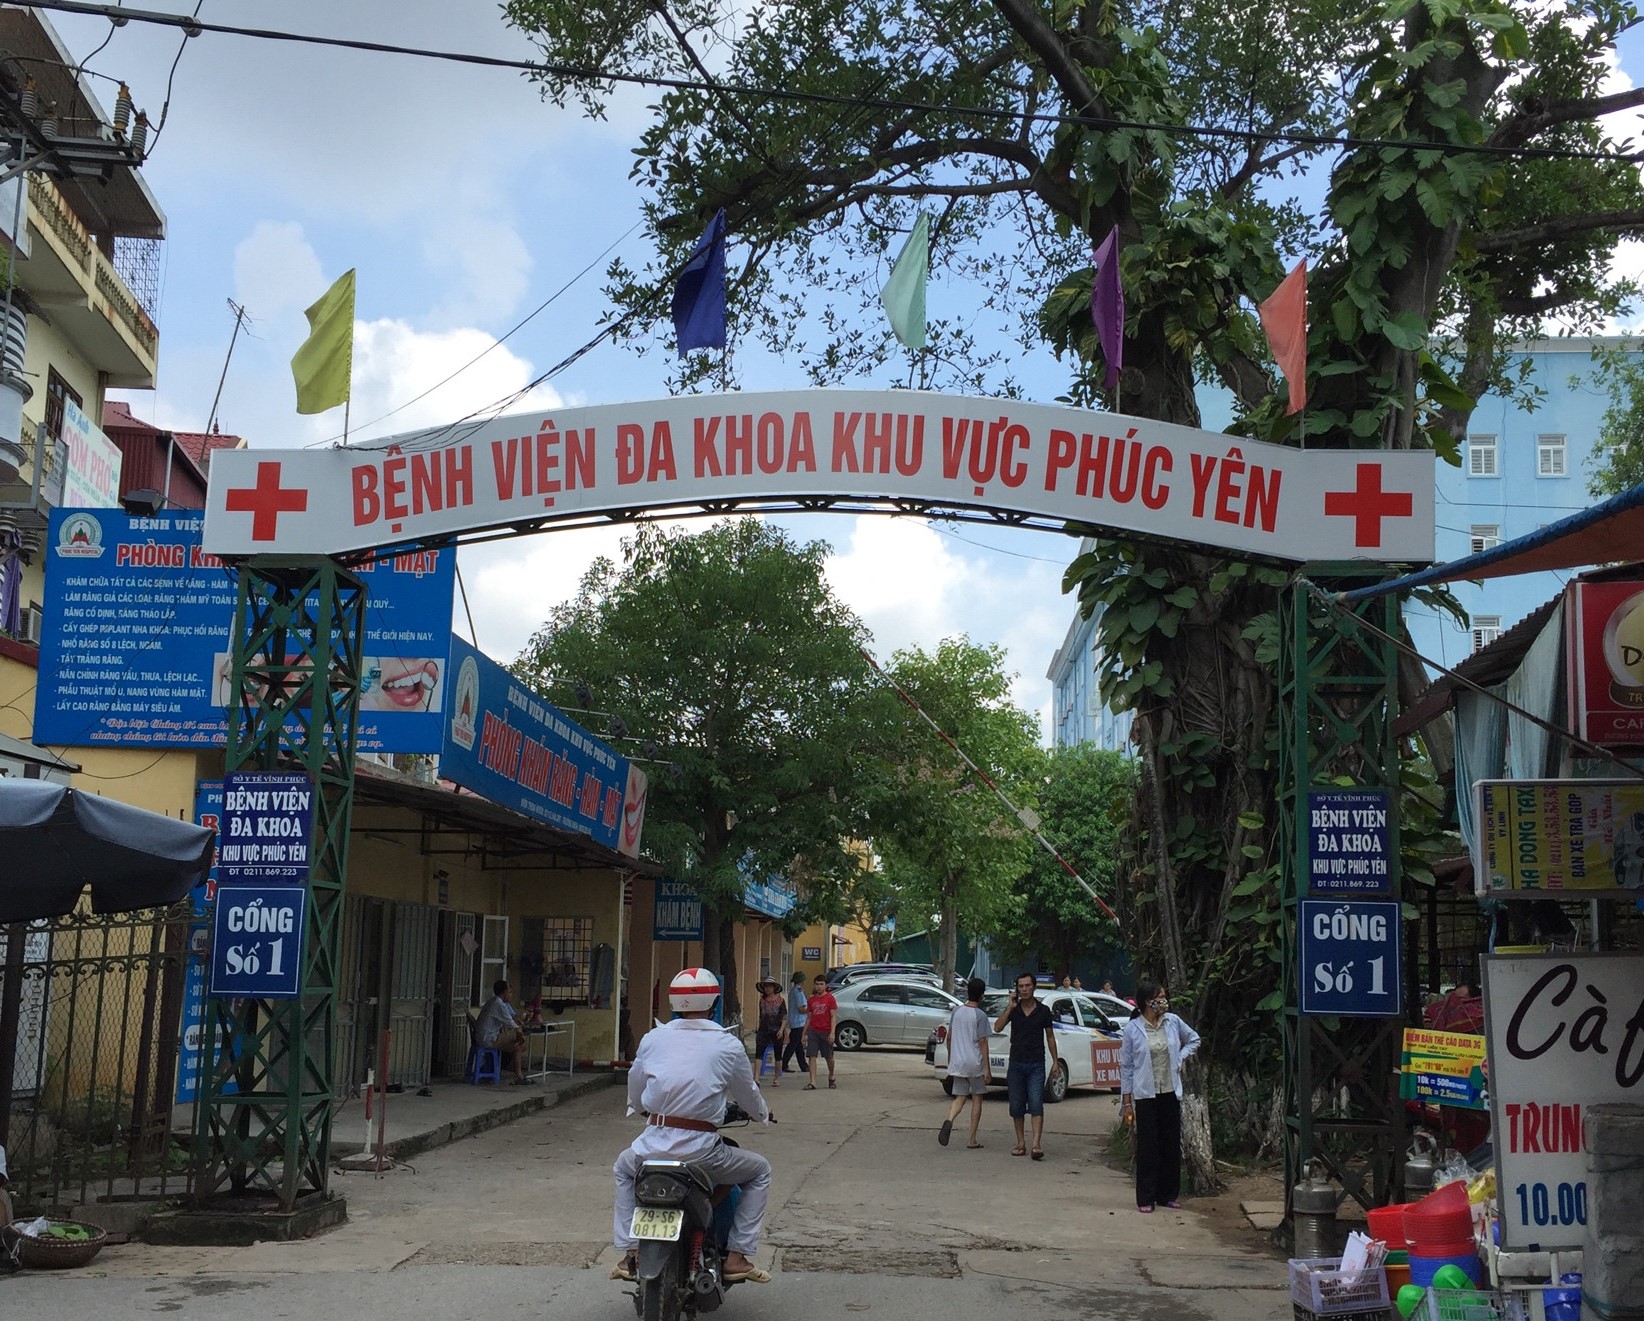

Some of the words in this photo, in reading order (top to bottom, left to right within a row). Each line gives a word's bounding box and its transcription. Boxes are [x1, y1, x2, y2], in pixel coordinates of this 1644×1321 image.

[351, 445, 473, 533] BỆNH
[491, 419, 596, 507] VIỆN
[615, 420, 677, 486] ĐA
[694, 411, 817, 478] KHOA
[831, 411, 925, 477] KHU
[942, 416, 1030, 497] VỰC
[1044, 428, 1173, 510] PHÚC
[1189, 447, 1282, 533] YÊN
[129, 517, 170, 533] BỆNH
[175, 517, 205, 533] VIỆ
[115, 538, 185, 568] PHÒNG
[66, 576, 87, 587] KHÁM
[89, 575, 109, 587] CHỮA
[110, 575, 124, 587] TẤT
[126, 576, 136, 587] CẢ
[137, 577, 152, 588] CÁC
[82, 592, 102, 602] RĂNG
[117, 592, 133, 603] CÁC
[64, 606, 84, 617] RĂNG
[85, 605, 96, 618] CỐ
[132, 625, 148, 634] NHA
[173, 625, 193, 638] PHỤC
[208, 625, 228, 636] RĂNG
[100, 637, 111, 649] SỐ
[111, 640, 117, 649] 8
[99, 670, 120, 680] RĂNG
[163, 671, 182, 683] LỆCH
[126, 688, 148, 697] NANG
[171, 687, 188, 697] HÀM
[72, 702, 88, 711] CAO
[89, 701, 109, 712] RĂNG
[132, 701, 150, 712] MÁY
[150, 702, 167, 712] SIÊU
[252, 773, 263, 783] TẾ
[477, 708, 522, 782] PHÒNG
[517, 735, 554, 797] KHÁM
[548, 748, 578, 810] RĂNG
[579, 766, 602, 821] HÀM
[602, 781, 622, 838] MẶT
[225, 786, 269, 815] BỆNH
[271, 786, 310, 815] VIỆN
[1312, 805, 1349, 832] BỆNH
[1352, 804, 1386, 832] VIỆN
[230, 818, 253, 837] ĐA
[256, 818, 303, 837] KHOA
[1318, 834, 1339, 852] ĐA
[1342, 834, 1382, 852] KHOA
[1570, 839, 1584, 853] XE
[222, 845, 242, 862] KHU
[242, 844, 261, 865] VỰC
[262, 841, 287, 862] PHÚC
[288, 842, 307, 862] YÊN
[229, 867, 240, 876] ĐT
[244, 867, 298, 876] 0211.869.223
[1313, 858, 1329, 874] KHU
[1330, 857, 1346, 877] VỰC
[1347, 856, 1370, 874] PHÚC
[1370, 856, 1386, 875] YÊN
[227, 898, 293, 933] CỔNG
[656, 898, 679, 928] KHÁM
[680, 899, 700, 931] BỆNH
[1313, 905, 1387, 942] CỔNG
[225, 941, 261, 976] Số
[266, 937, 285, 976] 1
[804, 948, 819, 957] WC
[1314, 960, 1354, 994] Số
[1367, 955, 1389, 995] 1
[1096, 1049, 1110, 1064] KHU
[1096, 1069, 1107, 1082] XE
[1107, 1066, 1121, 1081] MÁ
[1505, 1101, 1586, 1154] TRUN
[1516, 1182, 1587, 1226] 10.00
